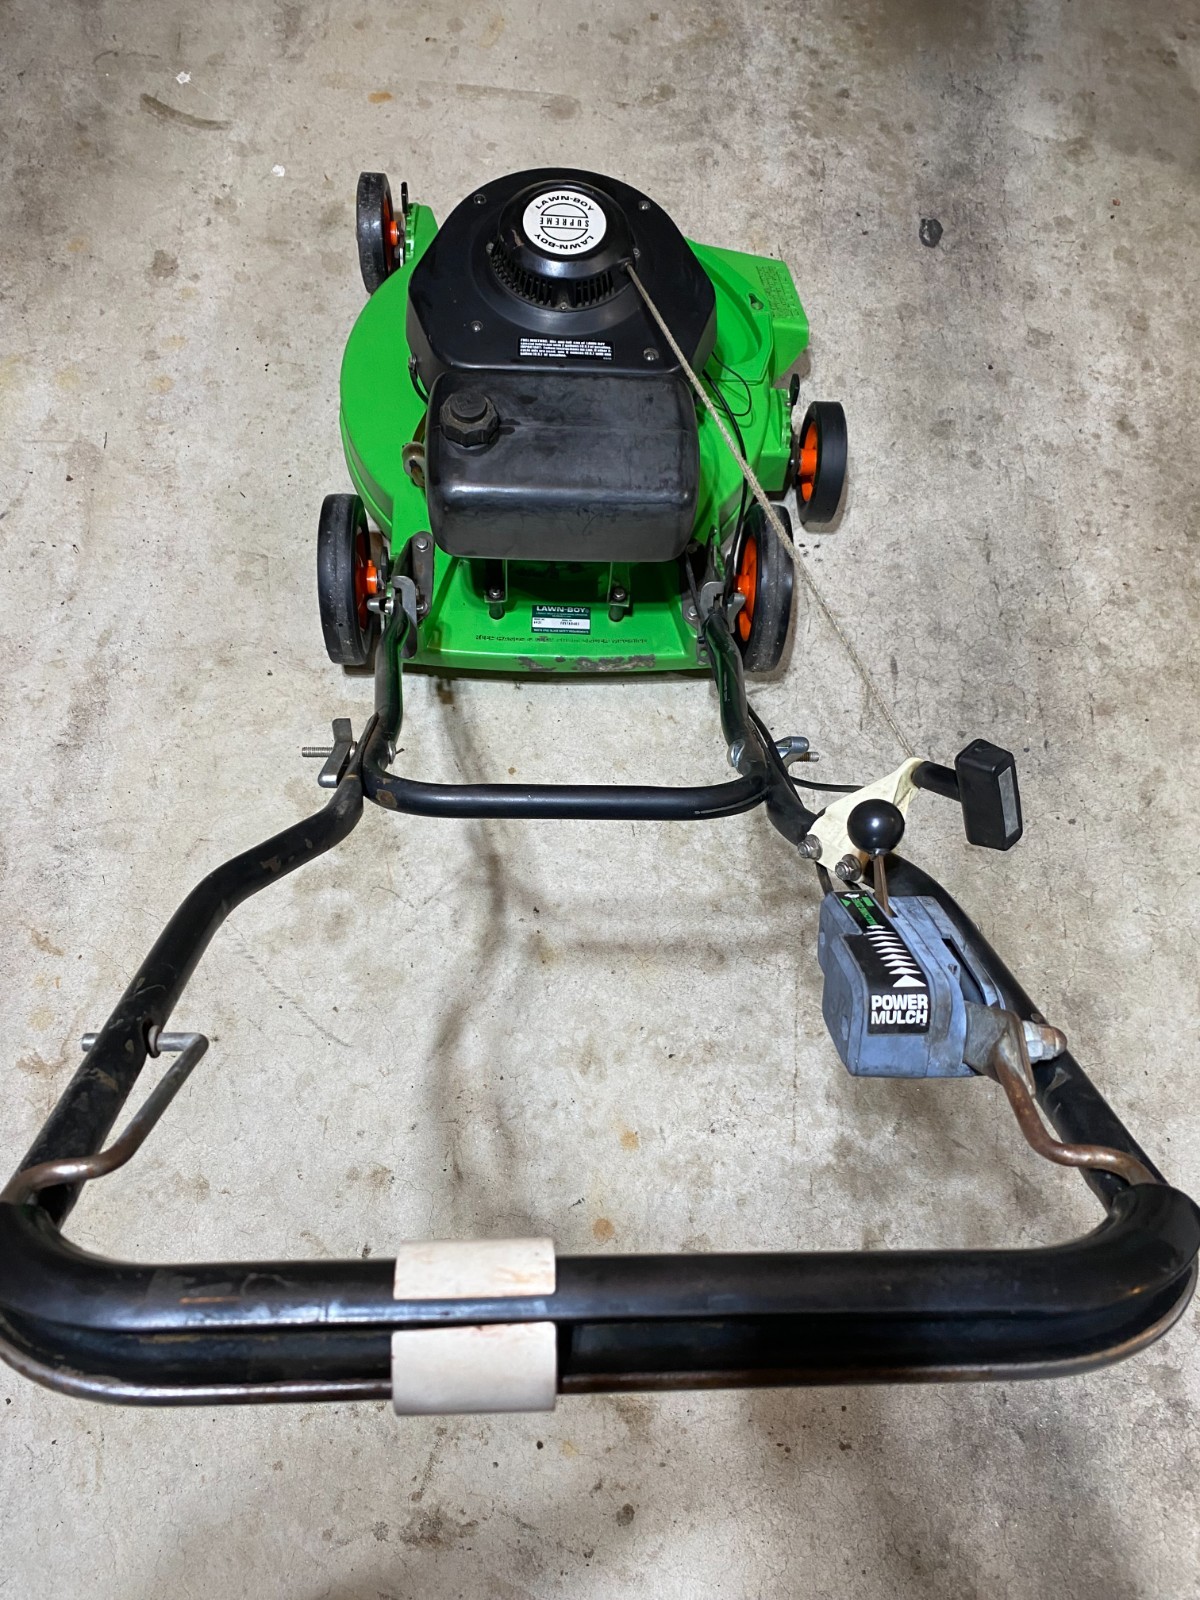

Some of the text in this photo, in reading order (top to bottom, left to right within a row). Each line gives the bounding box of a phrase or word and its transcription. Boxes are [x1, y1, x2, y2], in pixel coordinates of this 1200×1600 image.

[535, 195, 594, 211] LAWN-BOY
[539, 217, 589, 227] SUPREME
[534, 233, 594, 250] LAWN-BOY
[536, 605, 586, 613] LAWN-BOY
[871, 994, 928, 1010] POWER
[871, 1010, 928, 1024] MULCH
